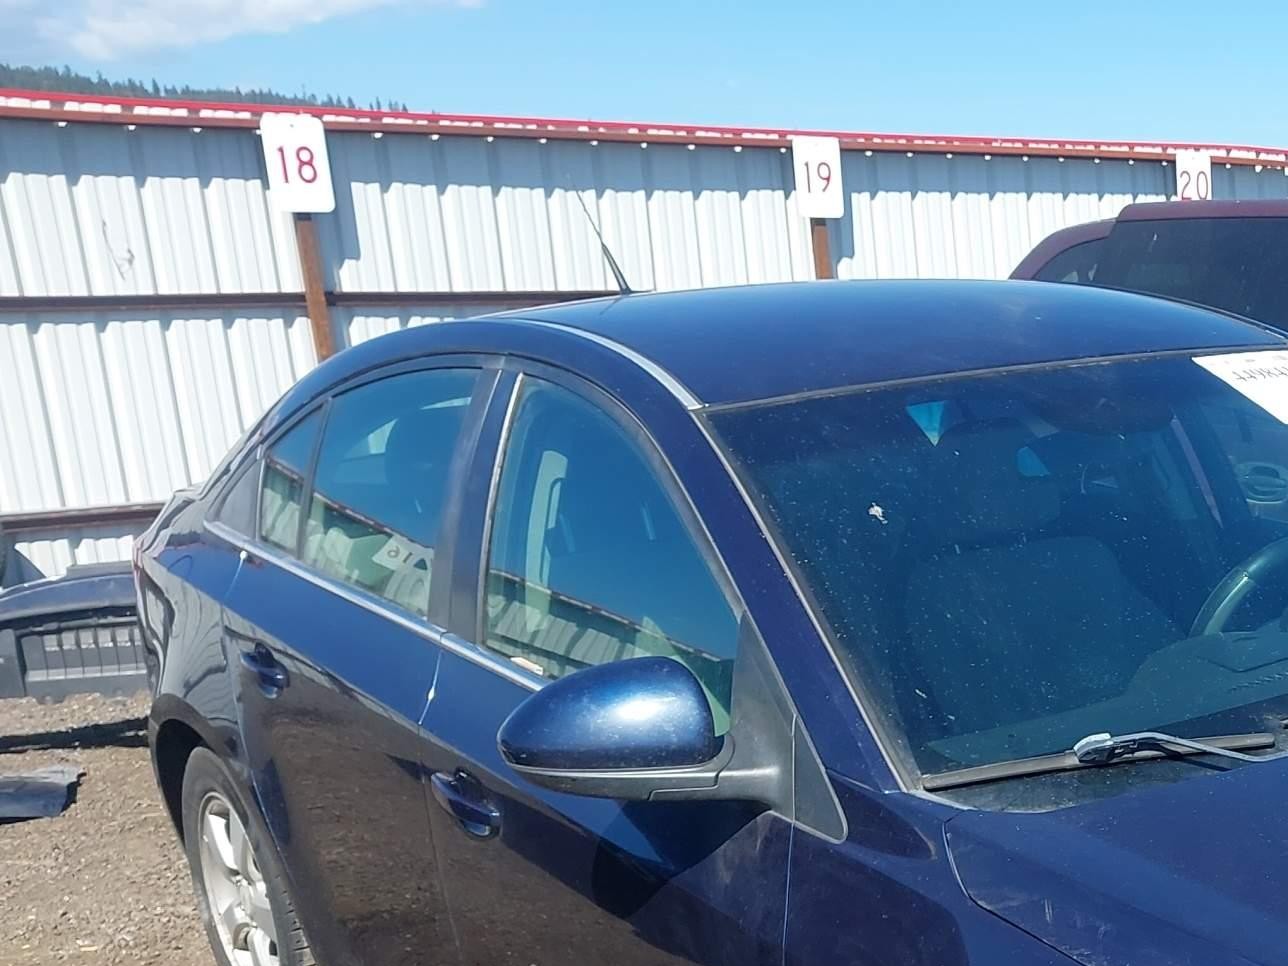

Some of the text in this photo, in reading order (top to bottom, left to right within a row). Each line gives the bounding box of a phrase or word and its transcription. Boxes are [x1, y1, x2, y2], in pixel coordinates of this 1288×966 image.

[277, 146, 318, 184] 18
[804, 162, 832, 193] 19
[1179, 170, 1209, 200] 20
